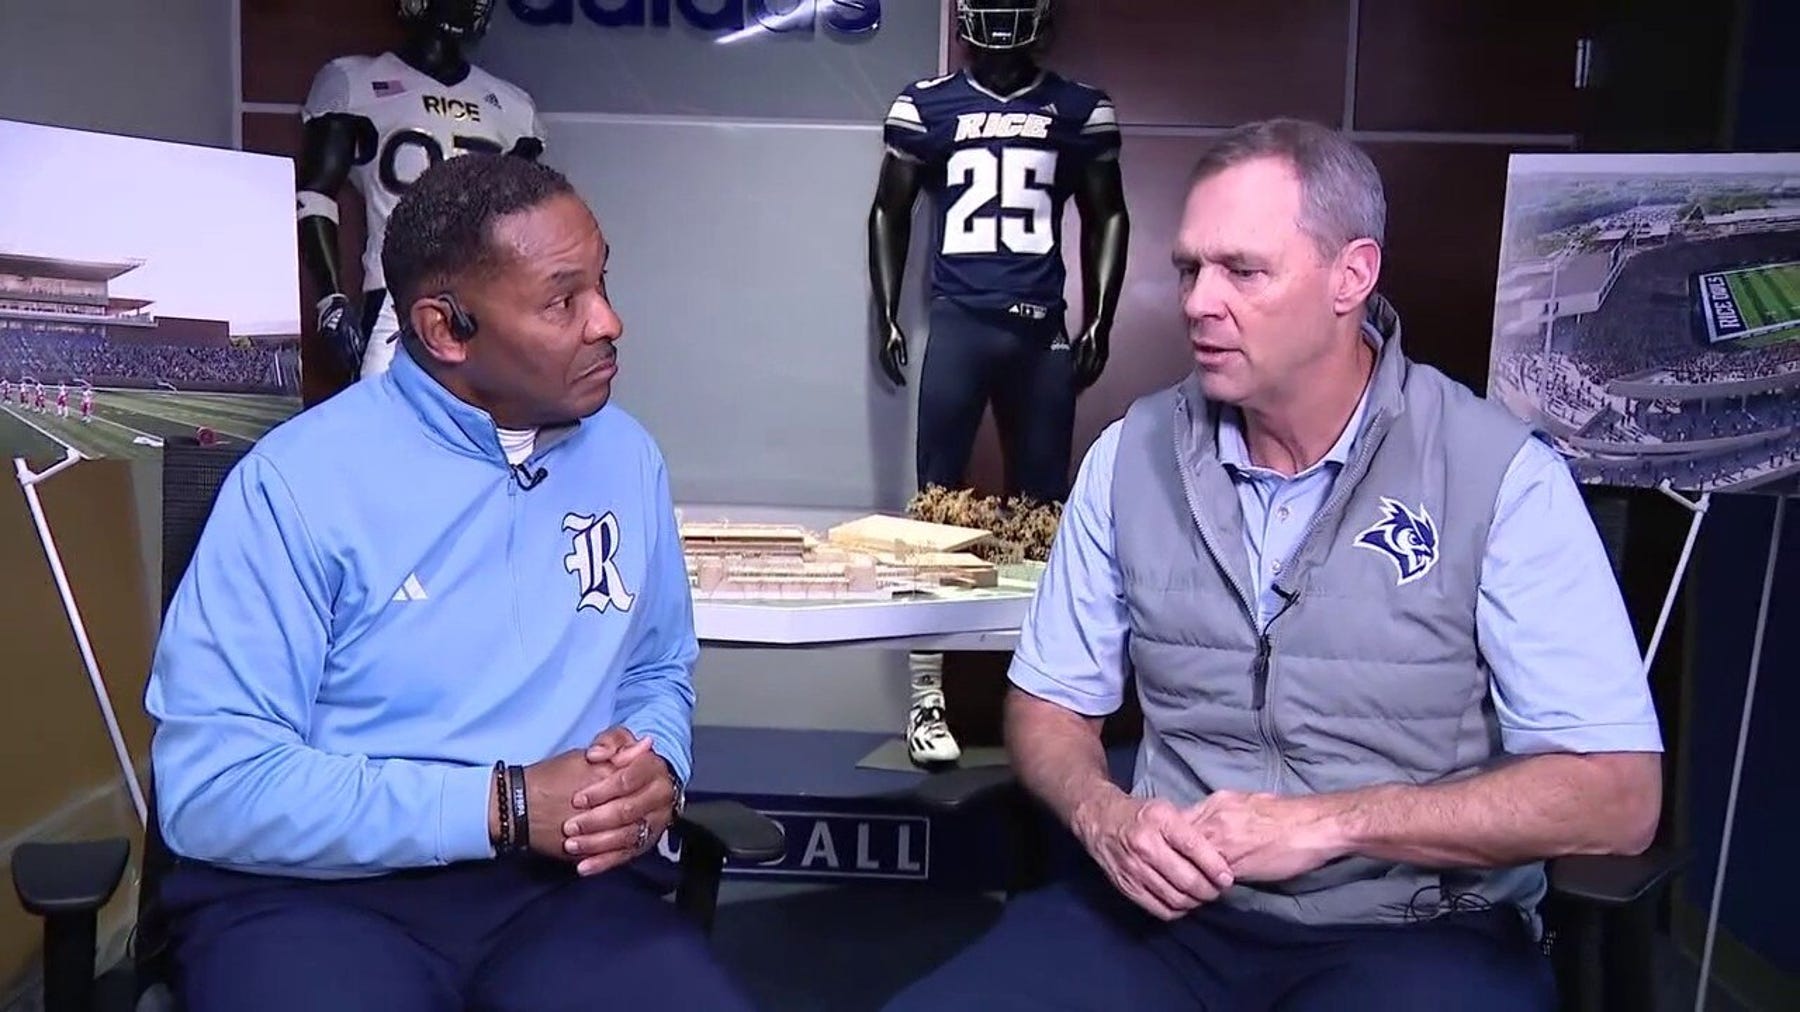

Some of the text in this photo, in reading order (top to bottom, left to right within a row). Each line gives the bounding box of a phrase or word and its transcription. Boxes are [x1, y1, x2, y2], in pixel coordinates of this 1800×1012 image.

[422, 95, 481, 122] RICE
[954, 112, 1053, 142] RICE
[941, 147, 1058, 254] 25
[1715, 301, 1741, 329] RICE
[561, 510, 635, 614] R
